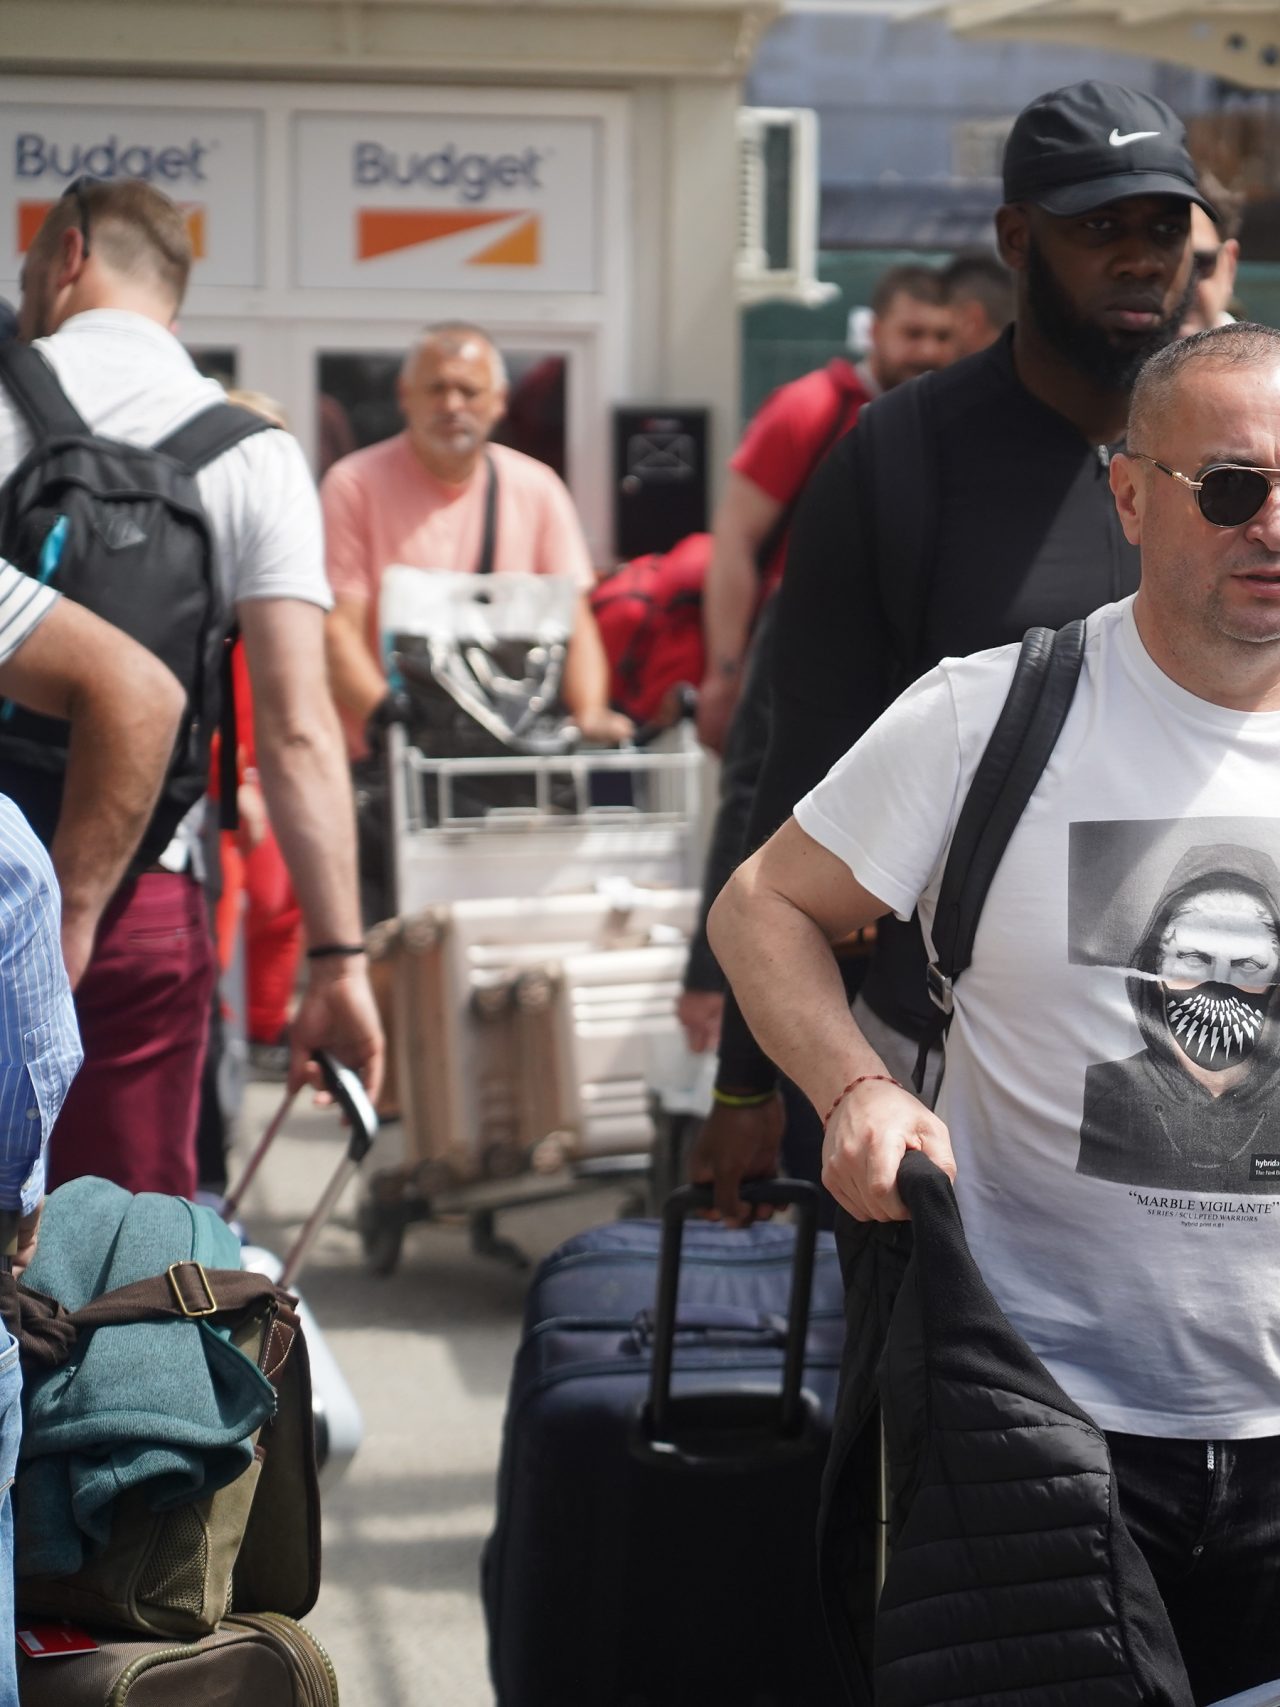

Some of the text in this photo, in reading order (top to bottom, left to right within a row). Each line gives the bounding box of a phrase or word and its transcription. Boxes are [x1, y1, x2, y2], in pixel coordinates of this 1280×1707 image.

[352, 140, 543, 202] Budget
[1147, 1209, 1174, 1217] SERIES
[1179, 1212, 1219, 1220] SCULPTED
[1219, 1214, 1258, 1222] WARRIORS
